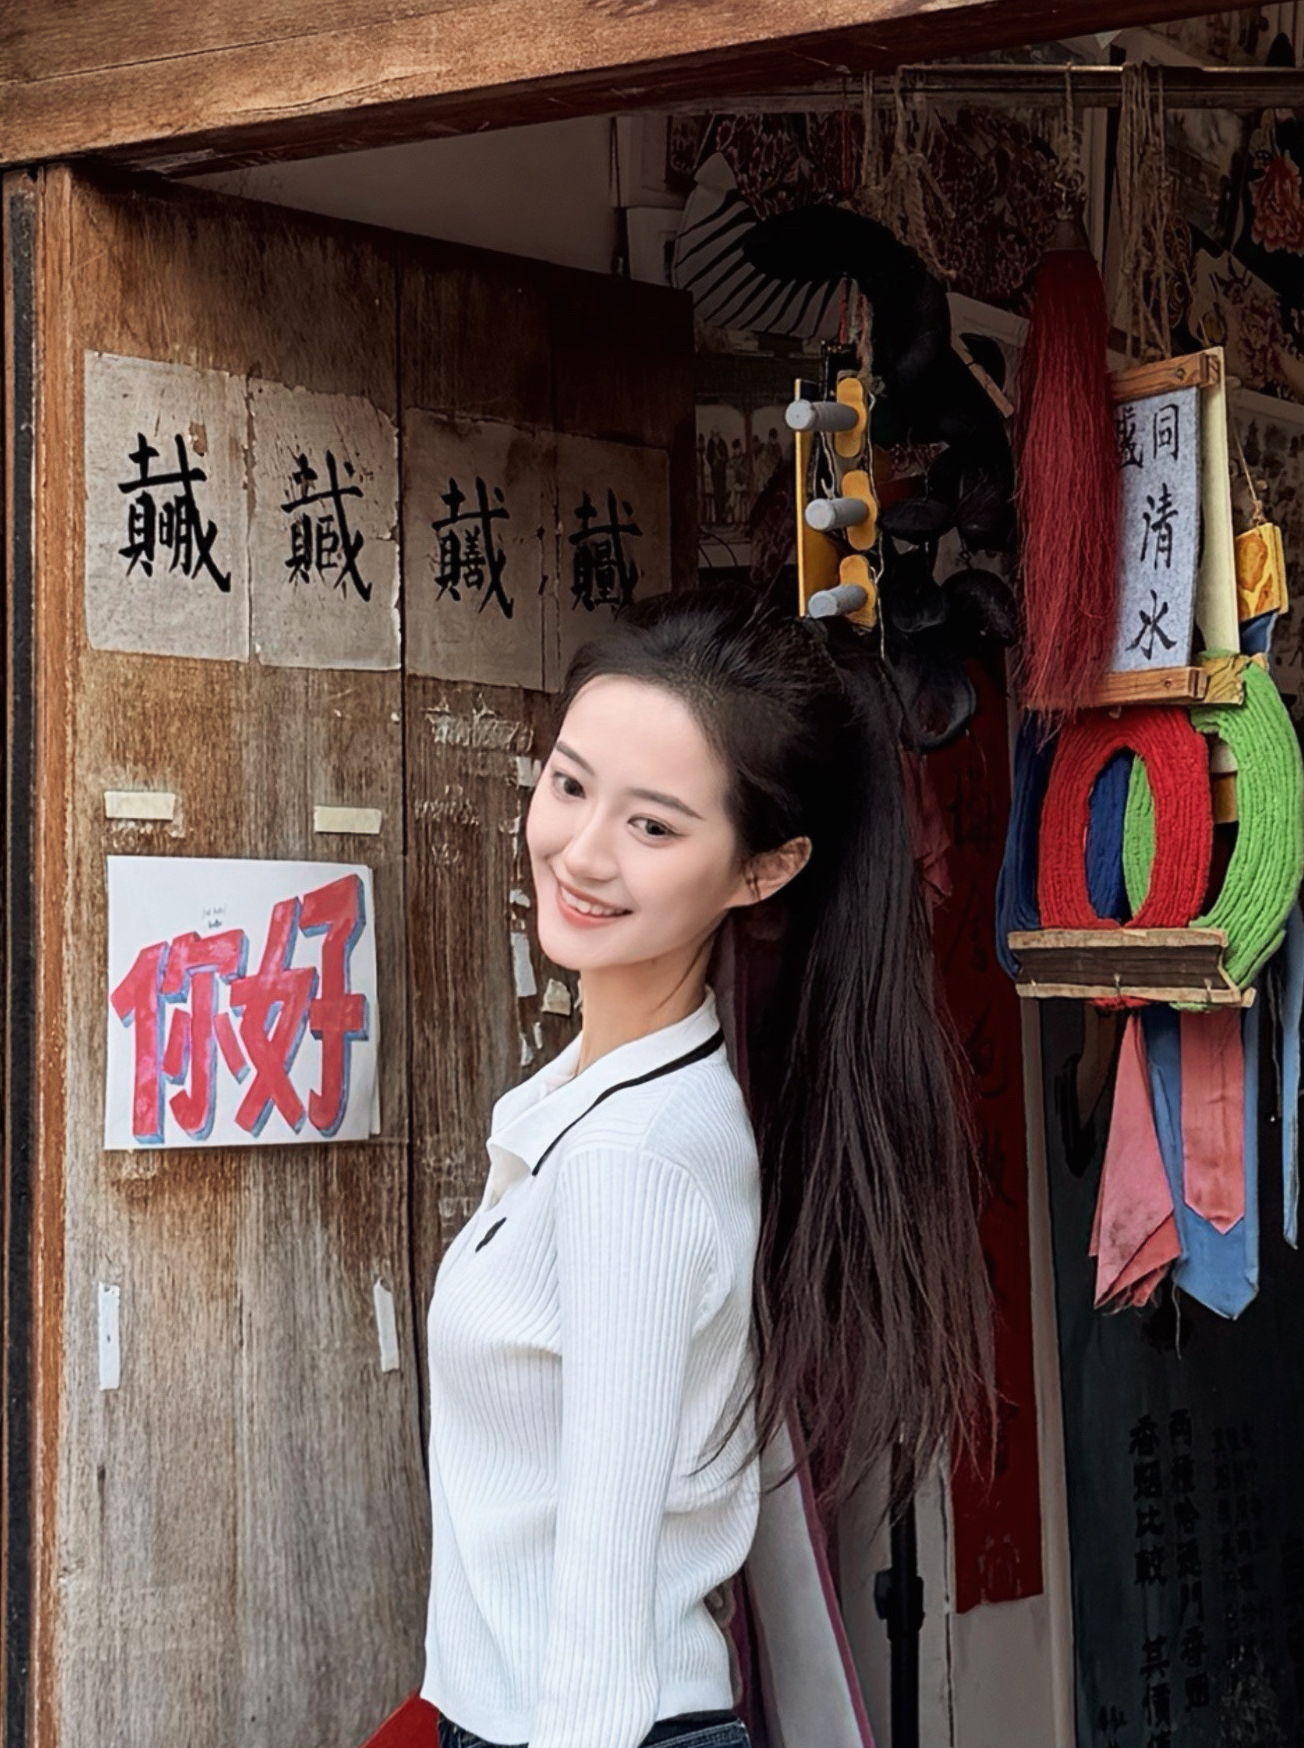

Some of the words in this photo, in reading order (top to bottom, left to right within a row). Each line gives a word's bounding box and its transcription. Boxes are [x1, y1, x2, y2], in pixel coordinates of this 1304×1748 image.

[1125, 402, 1180, 661] 同清水
[110, 872, 370, 1145] 你好
